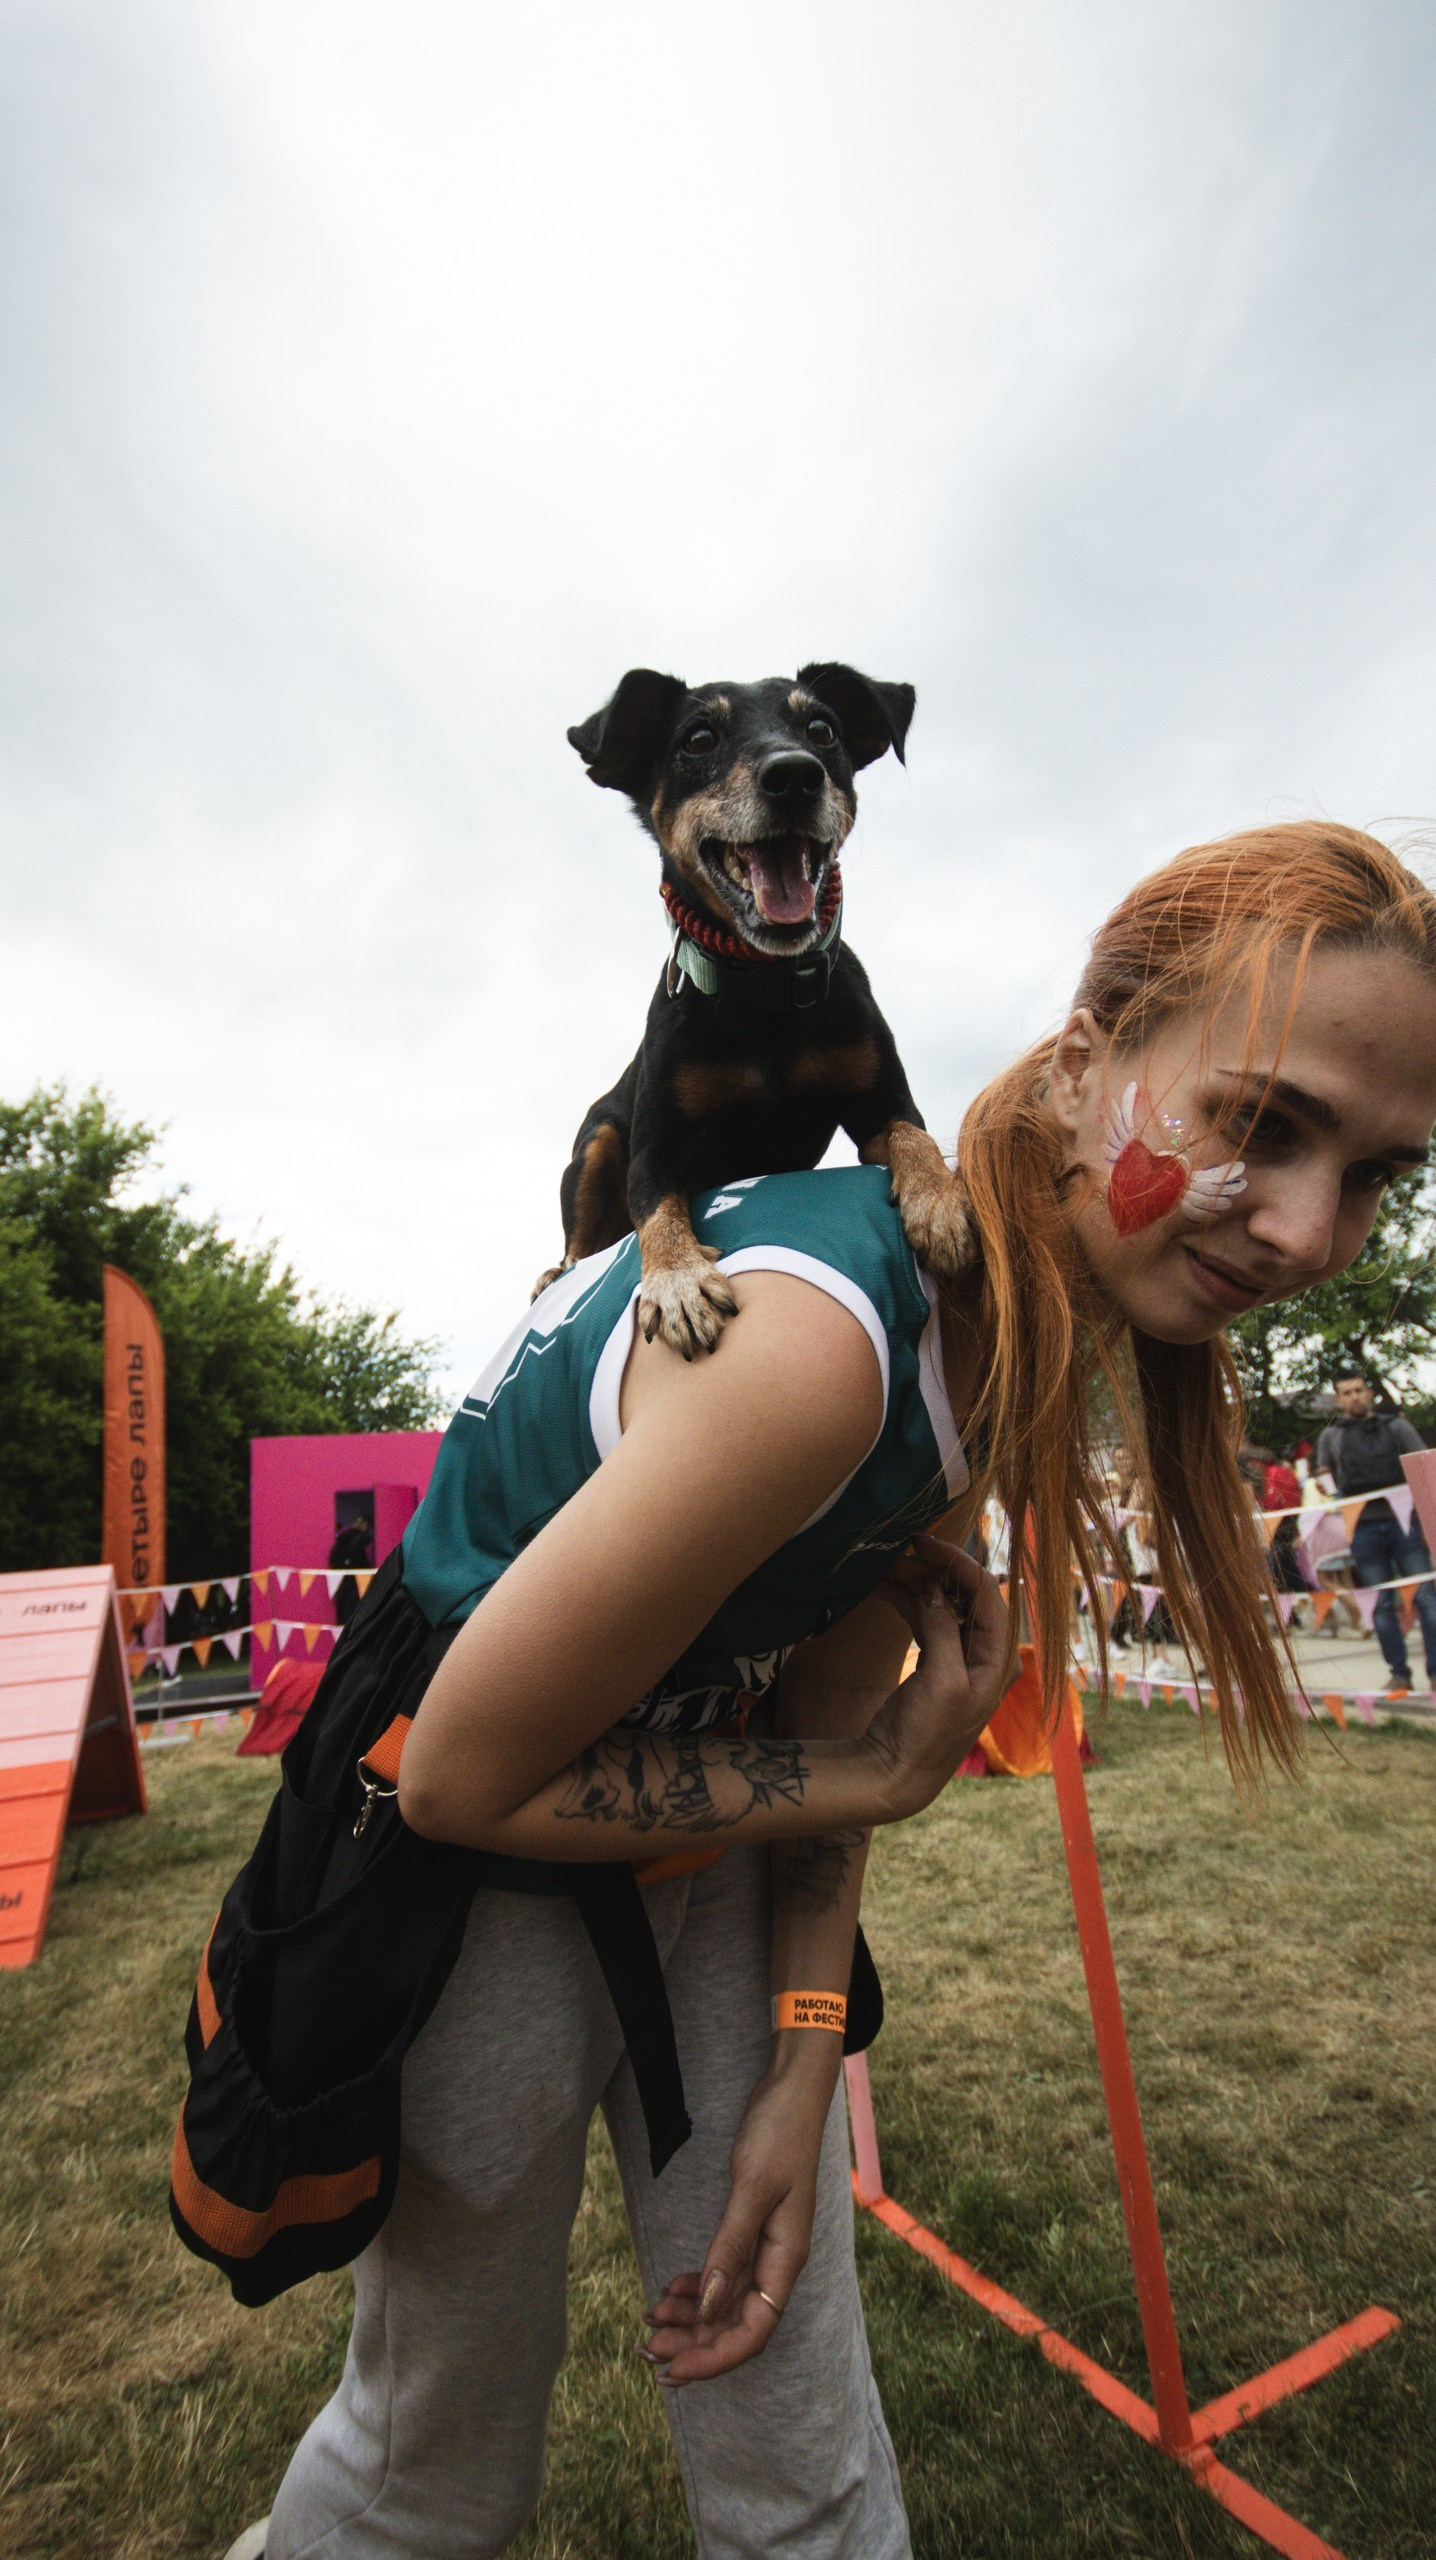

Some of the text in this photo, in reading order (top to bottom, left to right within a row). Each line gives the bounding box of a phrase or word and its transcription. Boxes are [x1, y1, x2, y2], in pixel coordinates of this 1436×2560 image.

[125, 1343, 149, 1592] етыре лапы
[794, 1999, 844, 2014] РАБОТАЮ
[794, 2012, 846, 2028] НА ФЕСТИ
